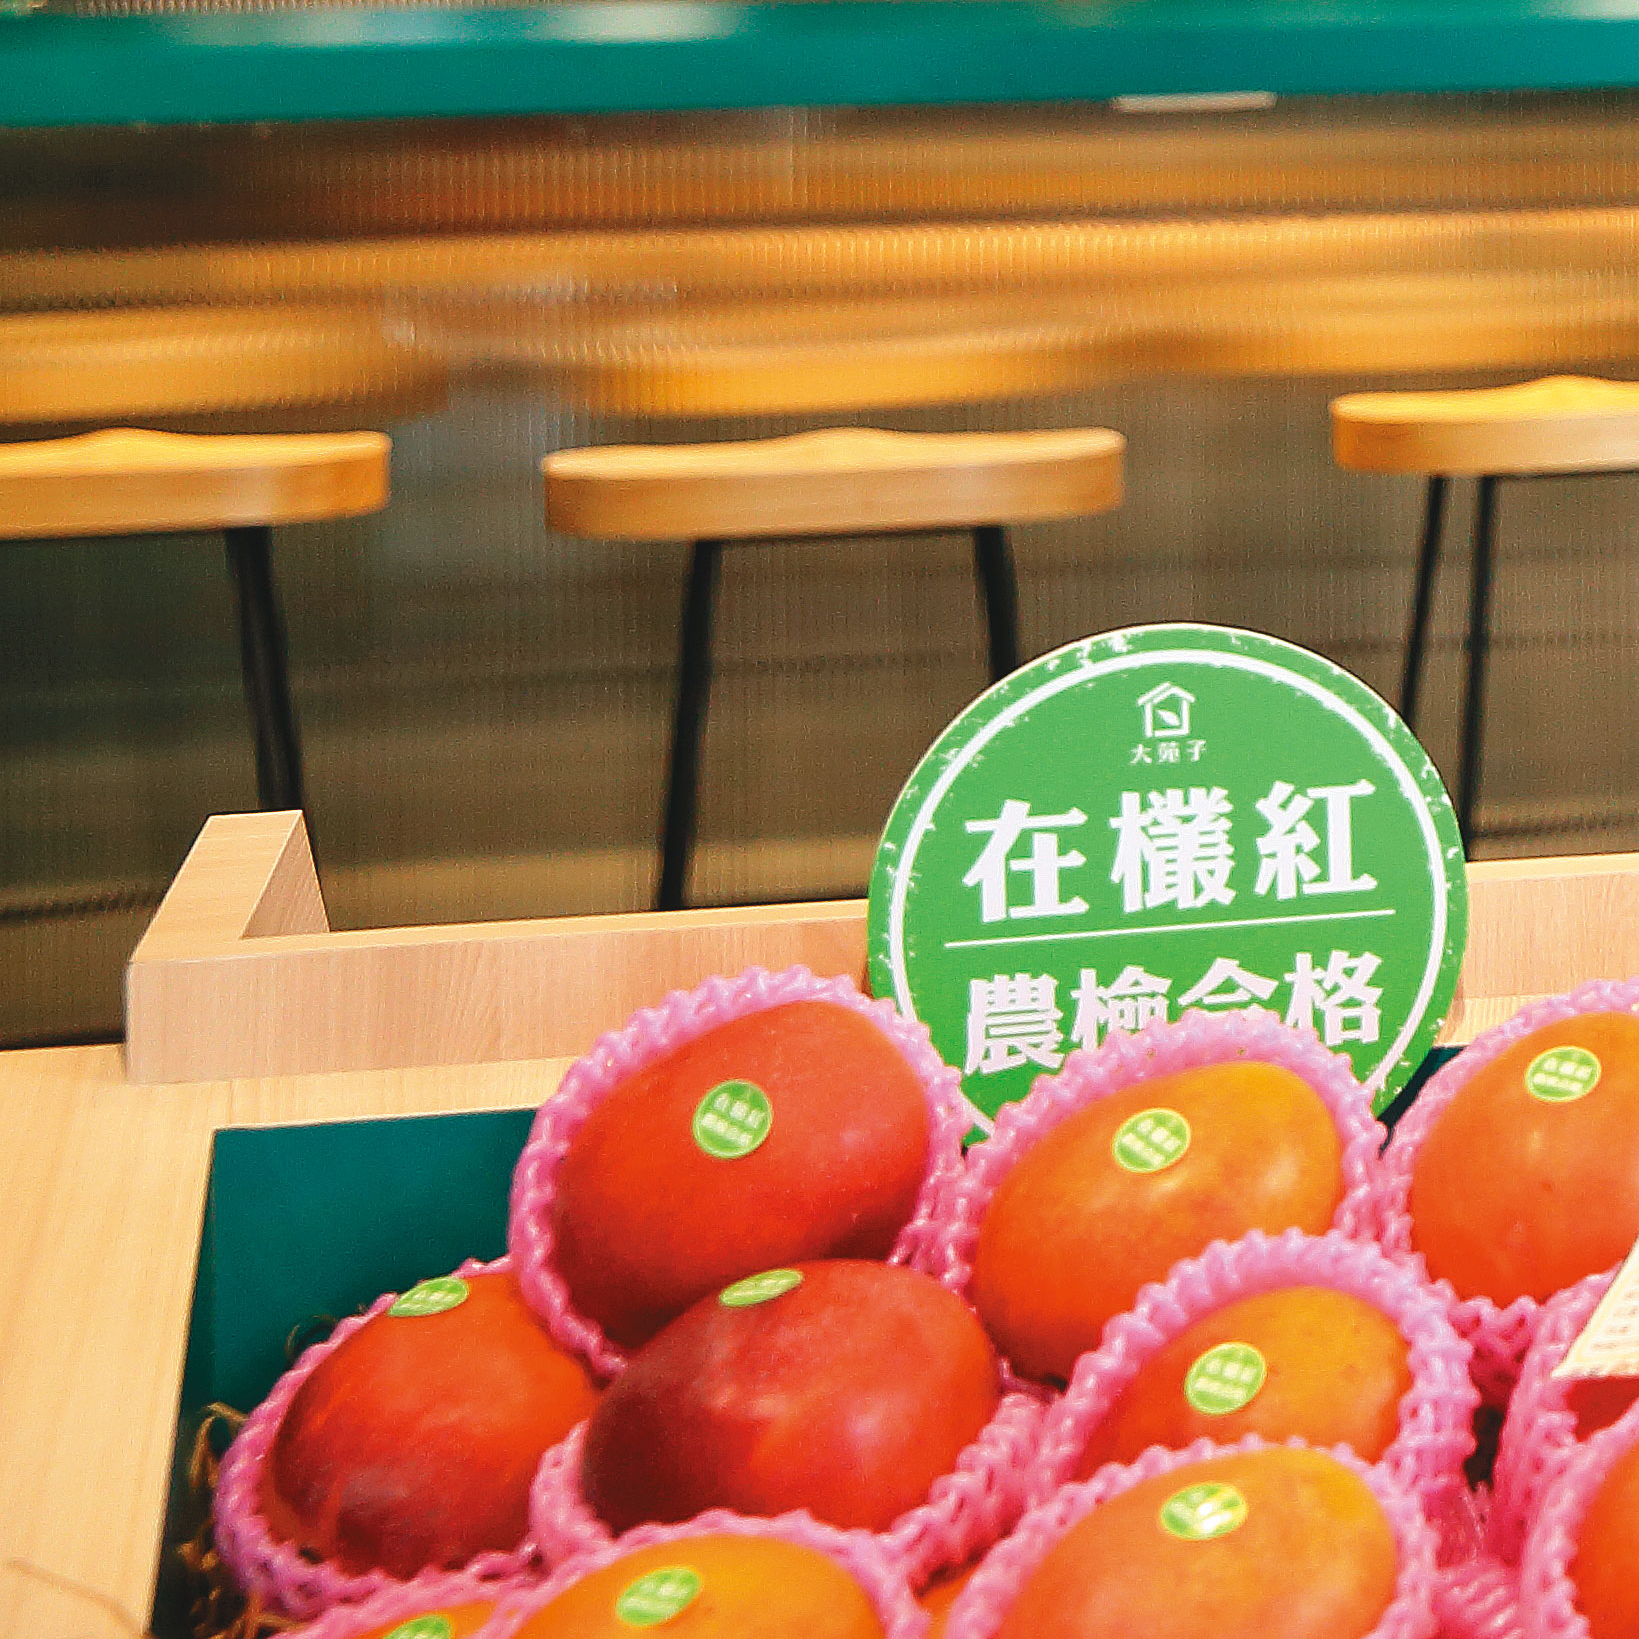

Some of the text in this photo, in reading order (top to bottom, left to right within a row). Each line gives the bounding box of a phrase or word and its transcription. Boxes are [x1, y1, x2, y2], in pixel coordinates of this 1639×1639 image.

[1129, 739, 1207, 765] 大苑子
[961, 777, 1379, 923] 在欉紅
